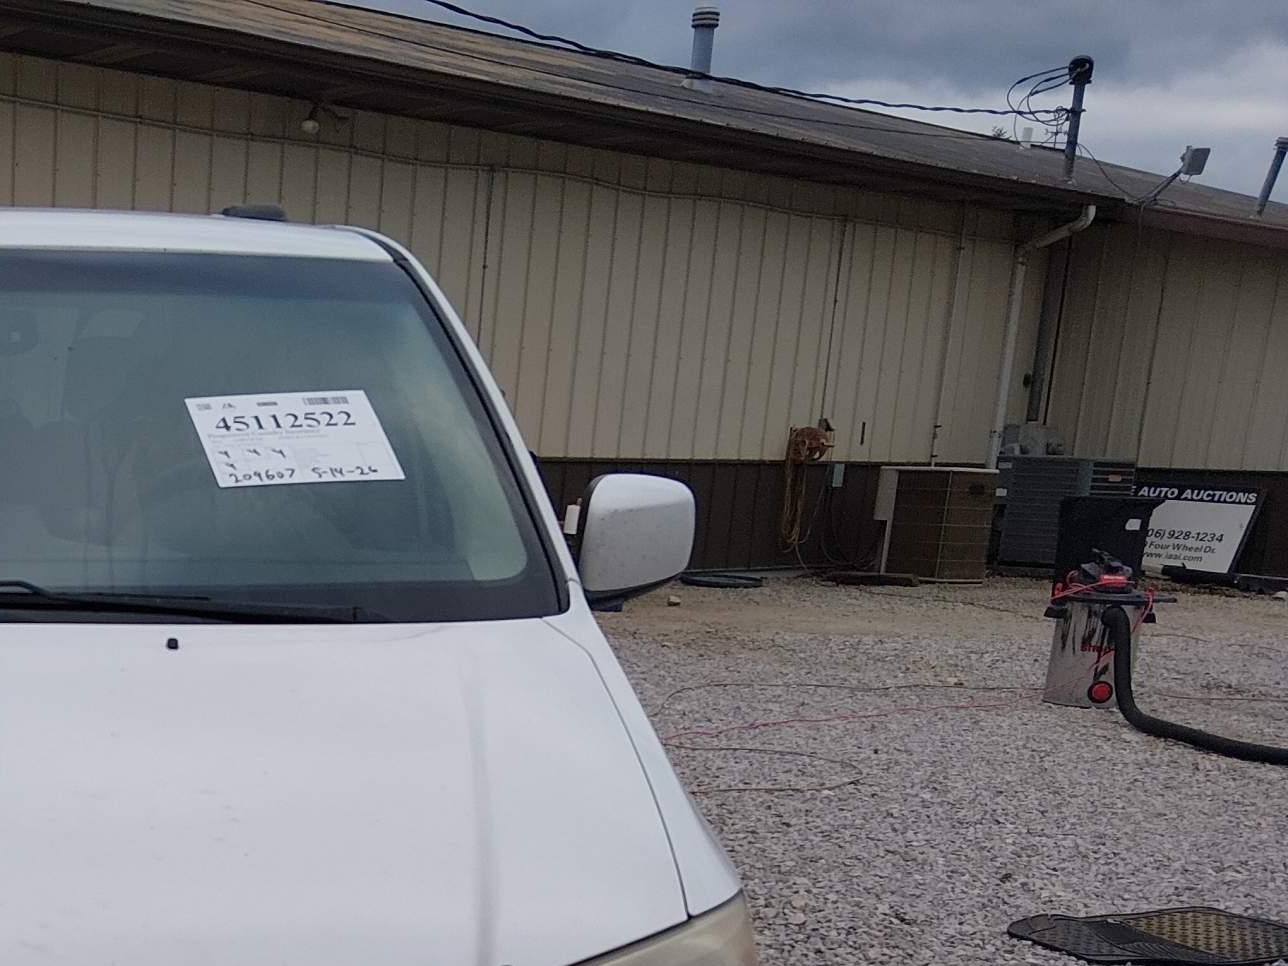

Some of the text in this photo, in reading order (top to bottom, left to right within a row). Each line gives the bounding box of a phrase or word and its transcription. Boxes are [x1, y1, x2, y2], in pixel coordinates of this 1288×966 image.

[215, 410, 356, 432] 45112522
[311, 465, 379, 479] 5-14-26
[1137, 486, 1179, 498] AUTO
[1181, 489, 1257, 503] AUCTIONS
[1167, 529, 1225, 543] 928-1234
[1148, 540, 1170, 550] Four
[1172, 542, 1203, 553] Wheel
